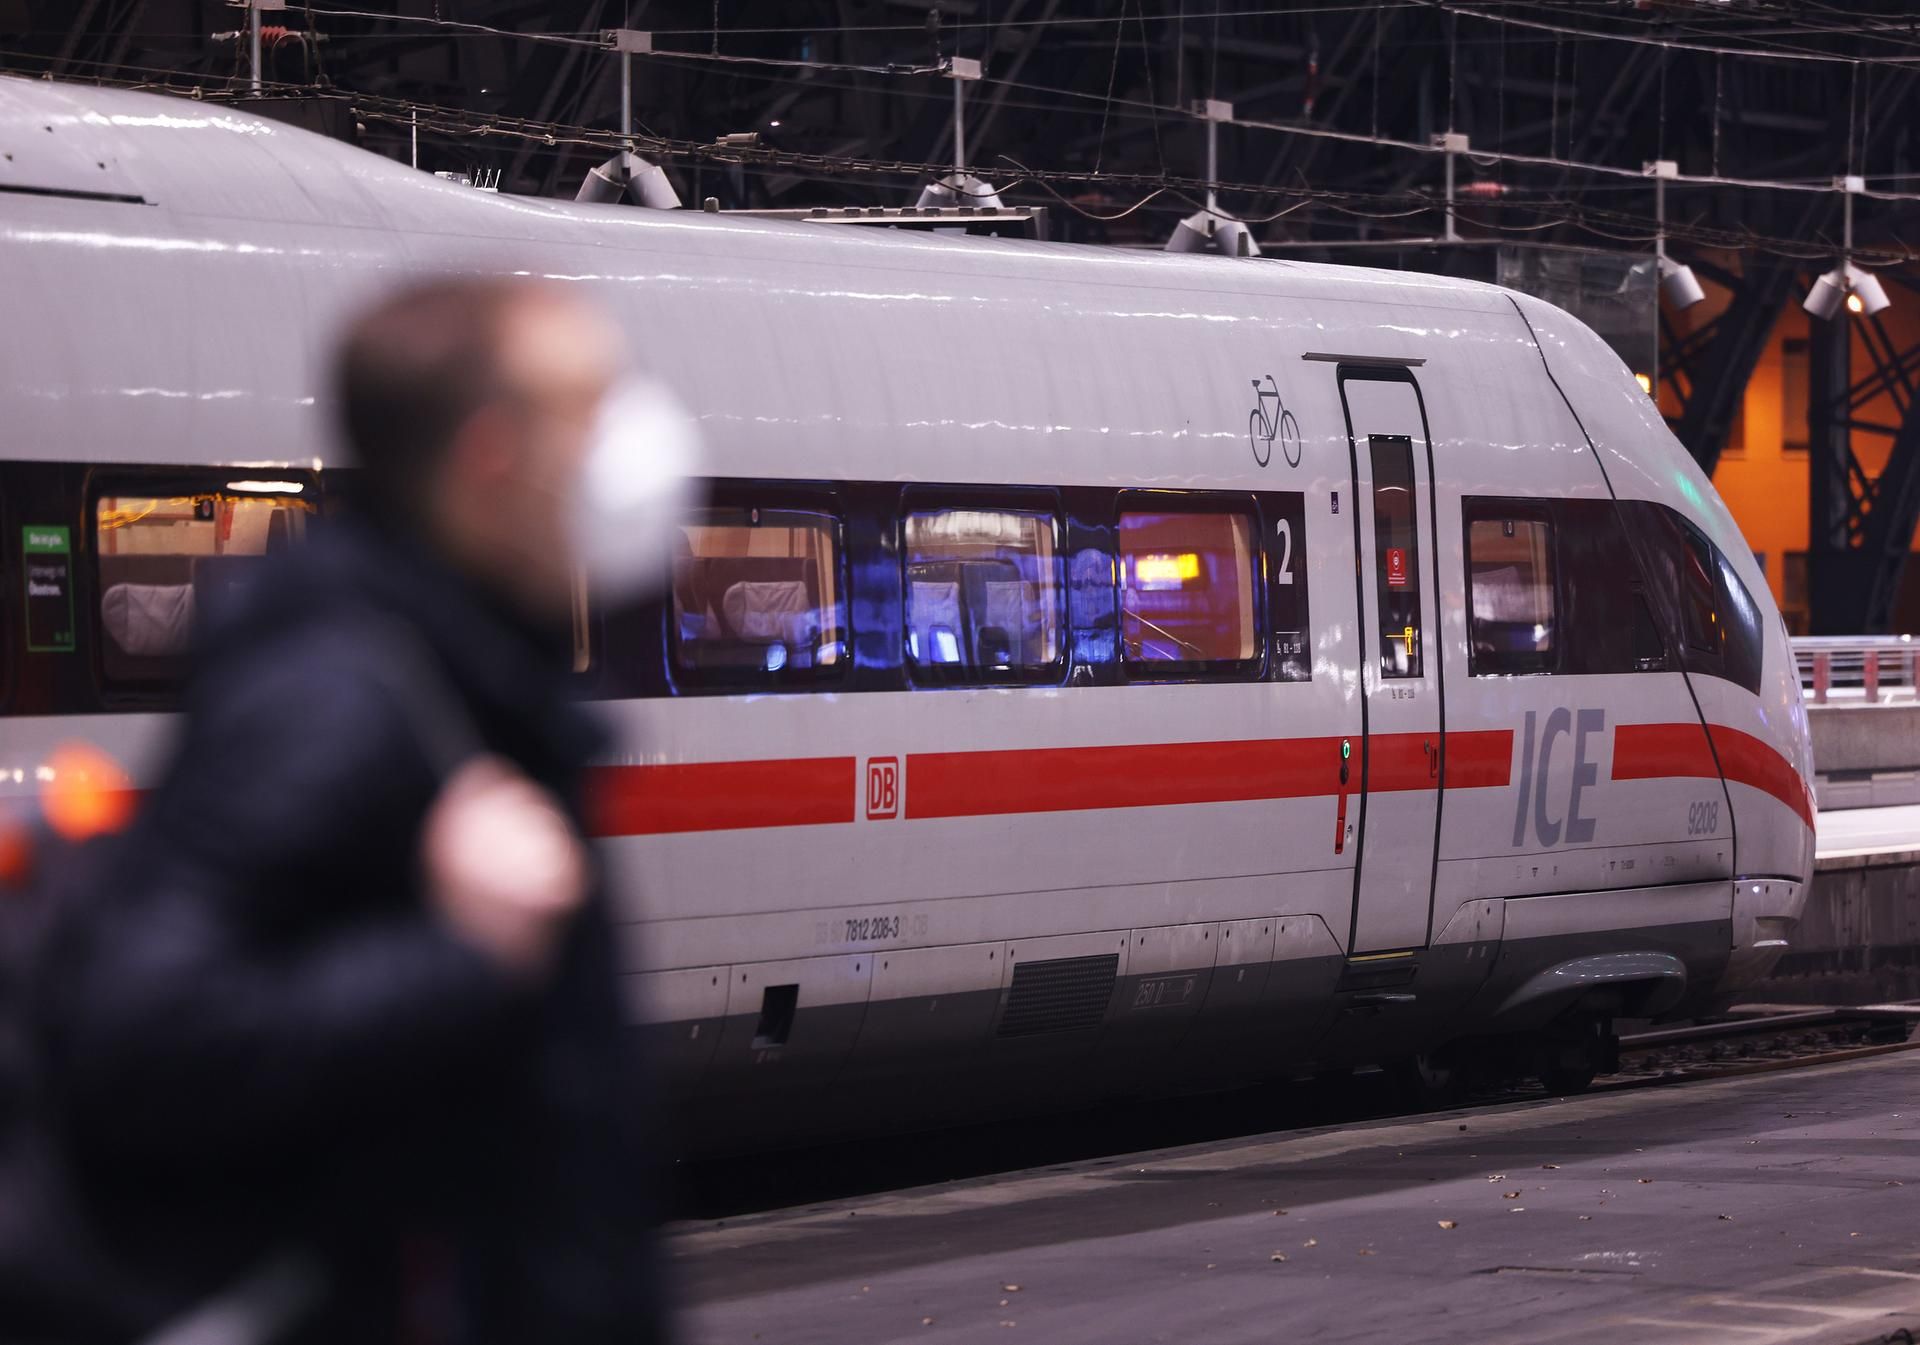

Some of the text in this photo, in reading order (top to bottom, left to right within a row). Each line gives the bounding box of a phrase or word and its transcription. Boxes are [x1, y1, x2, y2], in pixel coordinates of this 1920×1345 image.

[1276, 518, 1293, 585] 2
[870, 767, 895, 810] DB
[1511, 706, 1605, 848] ICE
[1687, 800, 1719, 836] 9208
[845, 918, 870, 942] 7812
[871, 916, 900, 940] 208-3
